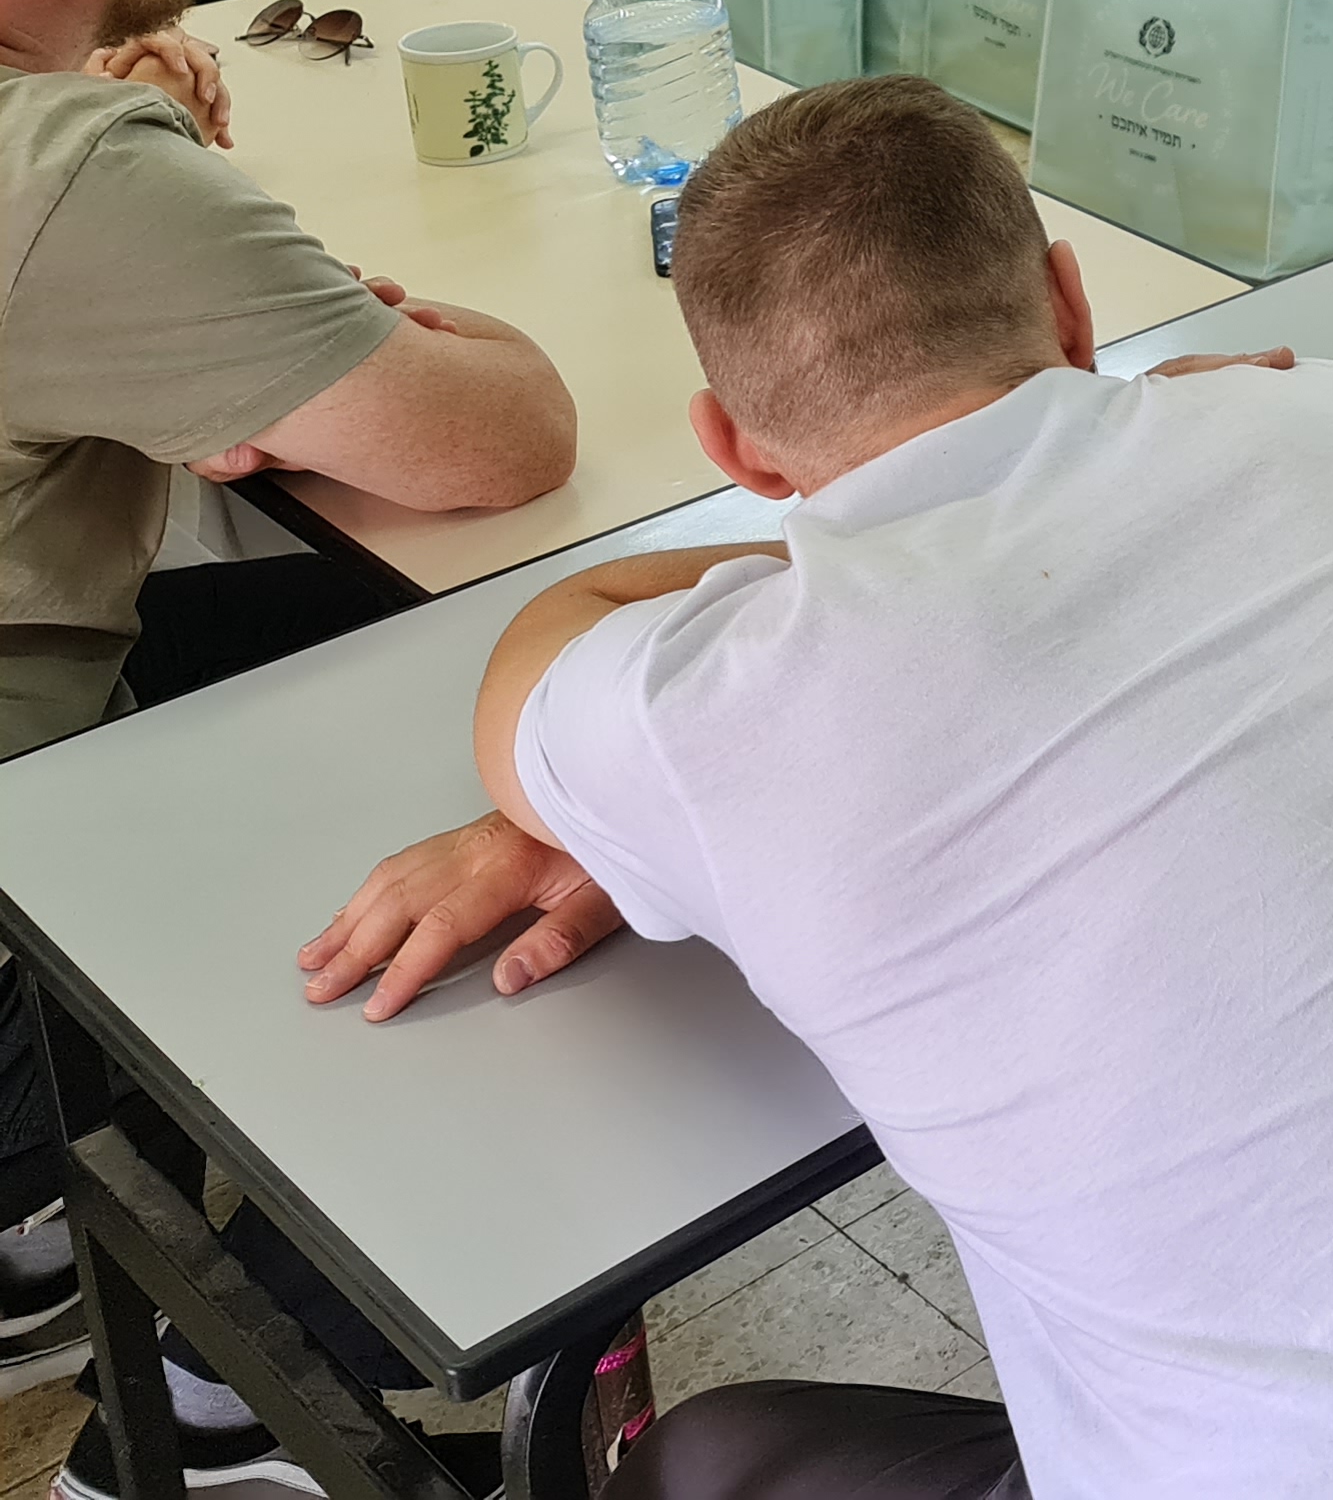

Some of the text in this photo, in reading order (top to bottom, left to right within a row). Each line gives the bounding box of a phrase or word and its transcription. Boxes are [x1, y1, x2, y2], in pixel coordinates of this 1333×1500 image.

[1088, 61, 1135, 107] We
[1141, 79, 1209, 129] Care
[1111, 114, 1182, 149] תמיד איתכם
